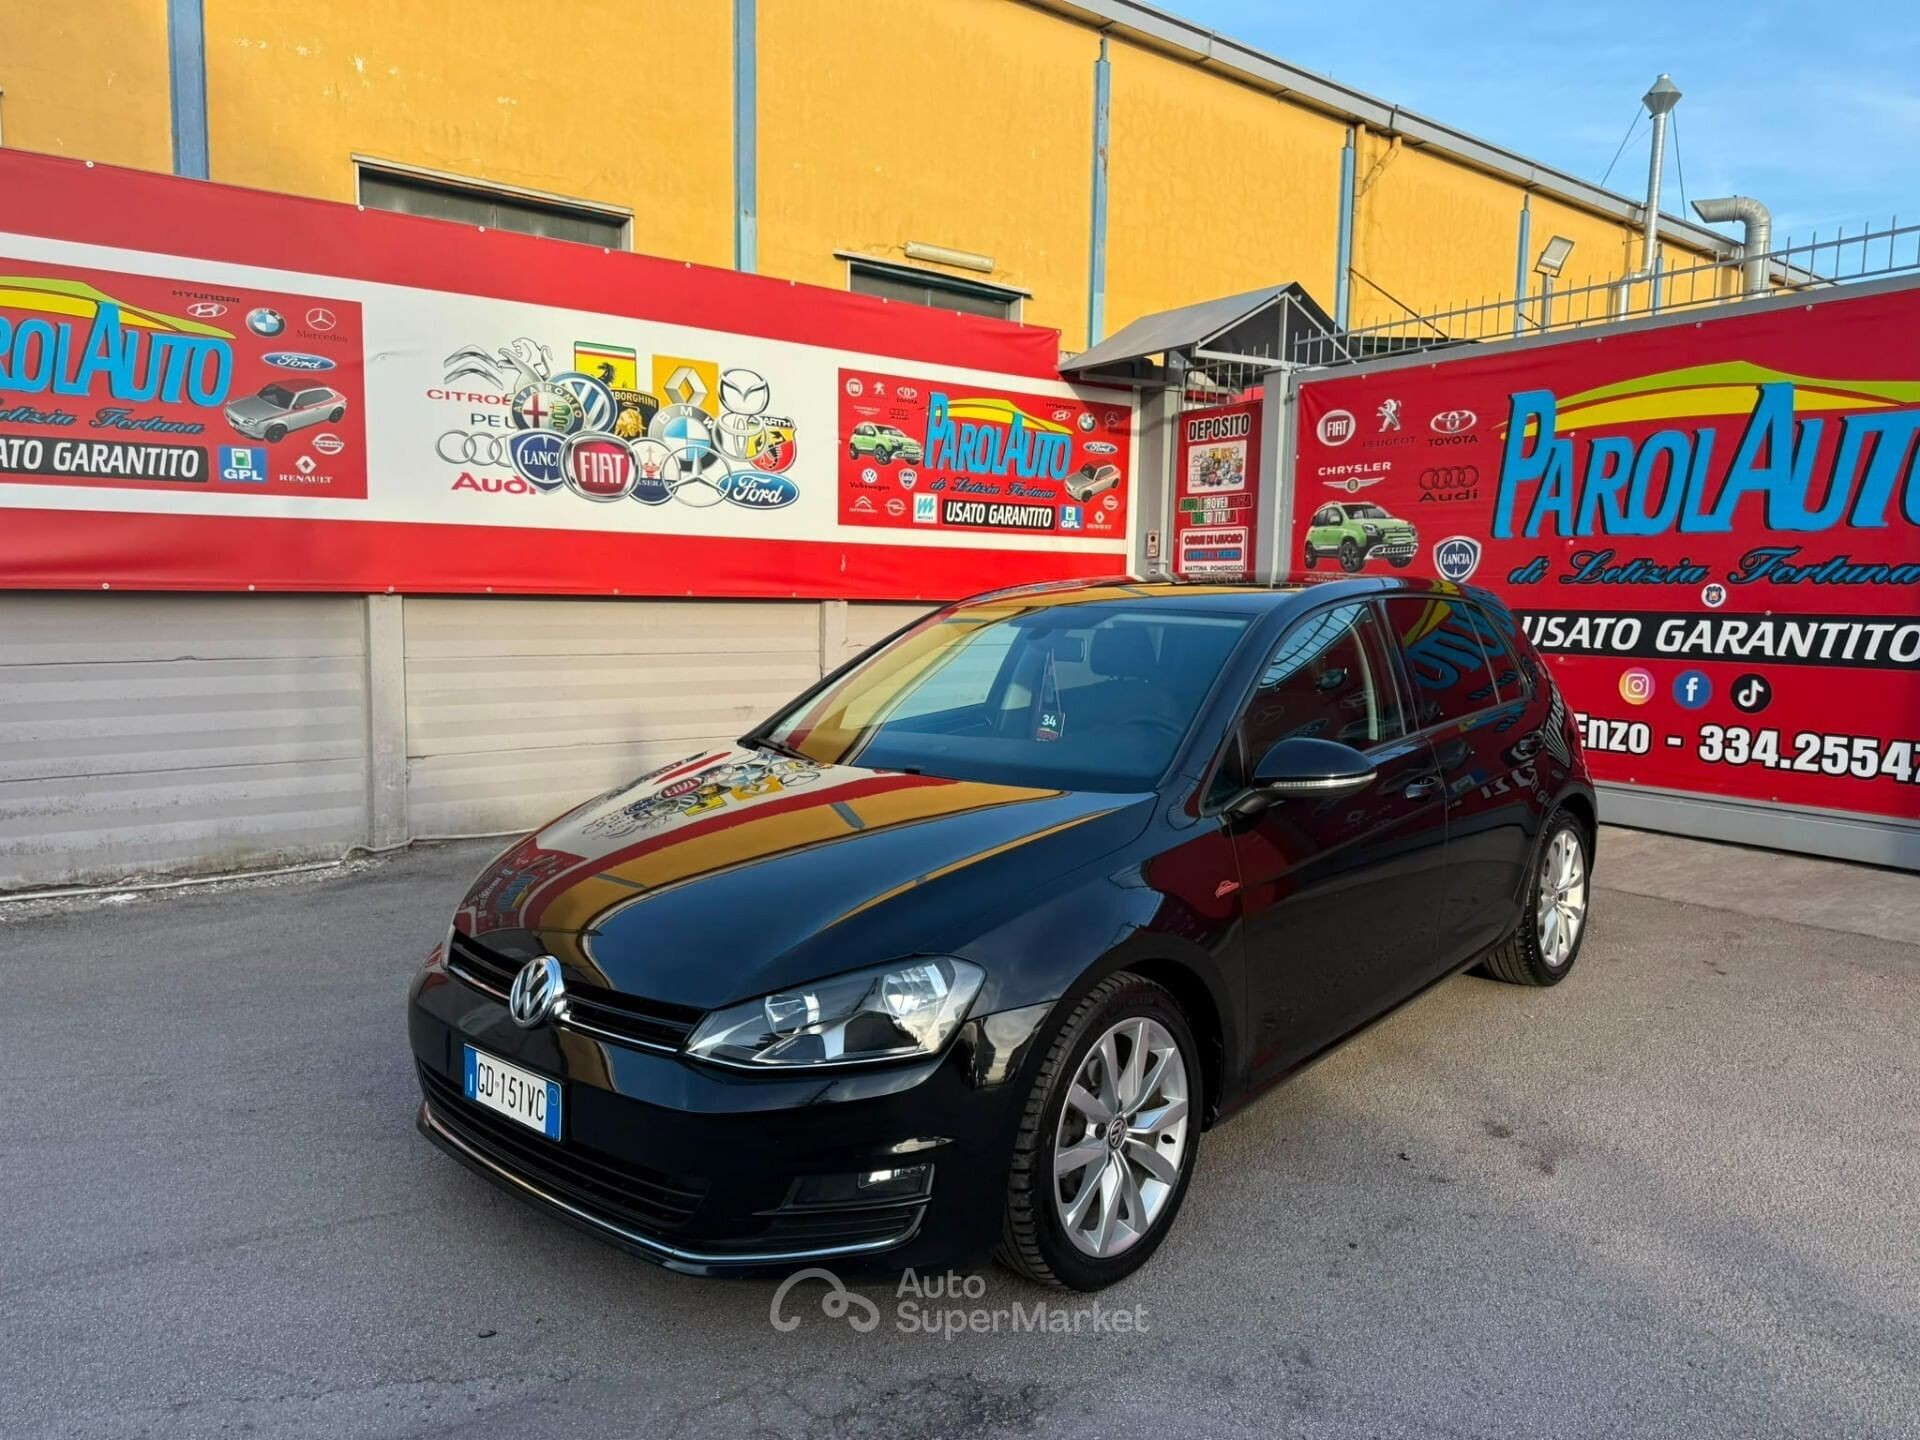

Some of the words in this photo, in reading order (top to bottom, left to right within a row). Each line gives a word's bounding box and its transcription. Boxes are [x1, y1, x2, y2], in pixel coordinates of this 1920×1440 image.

[277, 354, 321, 369] Ford
[658, 405, 715, 430] BMW
[1188, 414, 1250, 441] DEPOSITO
[1327, 419, 1349, 437] FIAT
[1362, 435, 1417, 448] PEUGEOT
[1428, 434, 1478, 447] TOYOTA
[53, 442, 199, 478] GARANTITO
[580, 451, 624, 484] FIAT
[223, 468, 263, 481] GPL
[1318, 461, 1392, 476] CHRYSLER
[279, 473, 333, 484] RENAULT
[733, 476, 783, 504] Ford
[1419, 489, 1478, 503] Audi
[947, 501, 986, 523] USATO
[988, 505, 1052, 527] GARANTITO
[1061, 520, 1081, 530] GPL
[1443, 553, 1470, 565] LANCIA
[1507, 556, 1550, 585] di
[1560, 549, 1709, 585] Letizia
[1523, 616, 1641, 652] USATO
[1655, 618, 1920, 663] GARANTITO
[1042, 713, 1057, 727] 34
